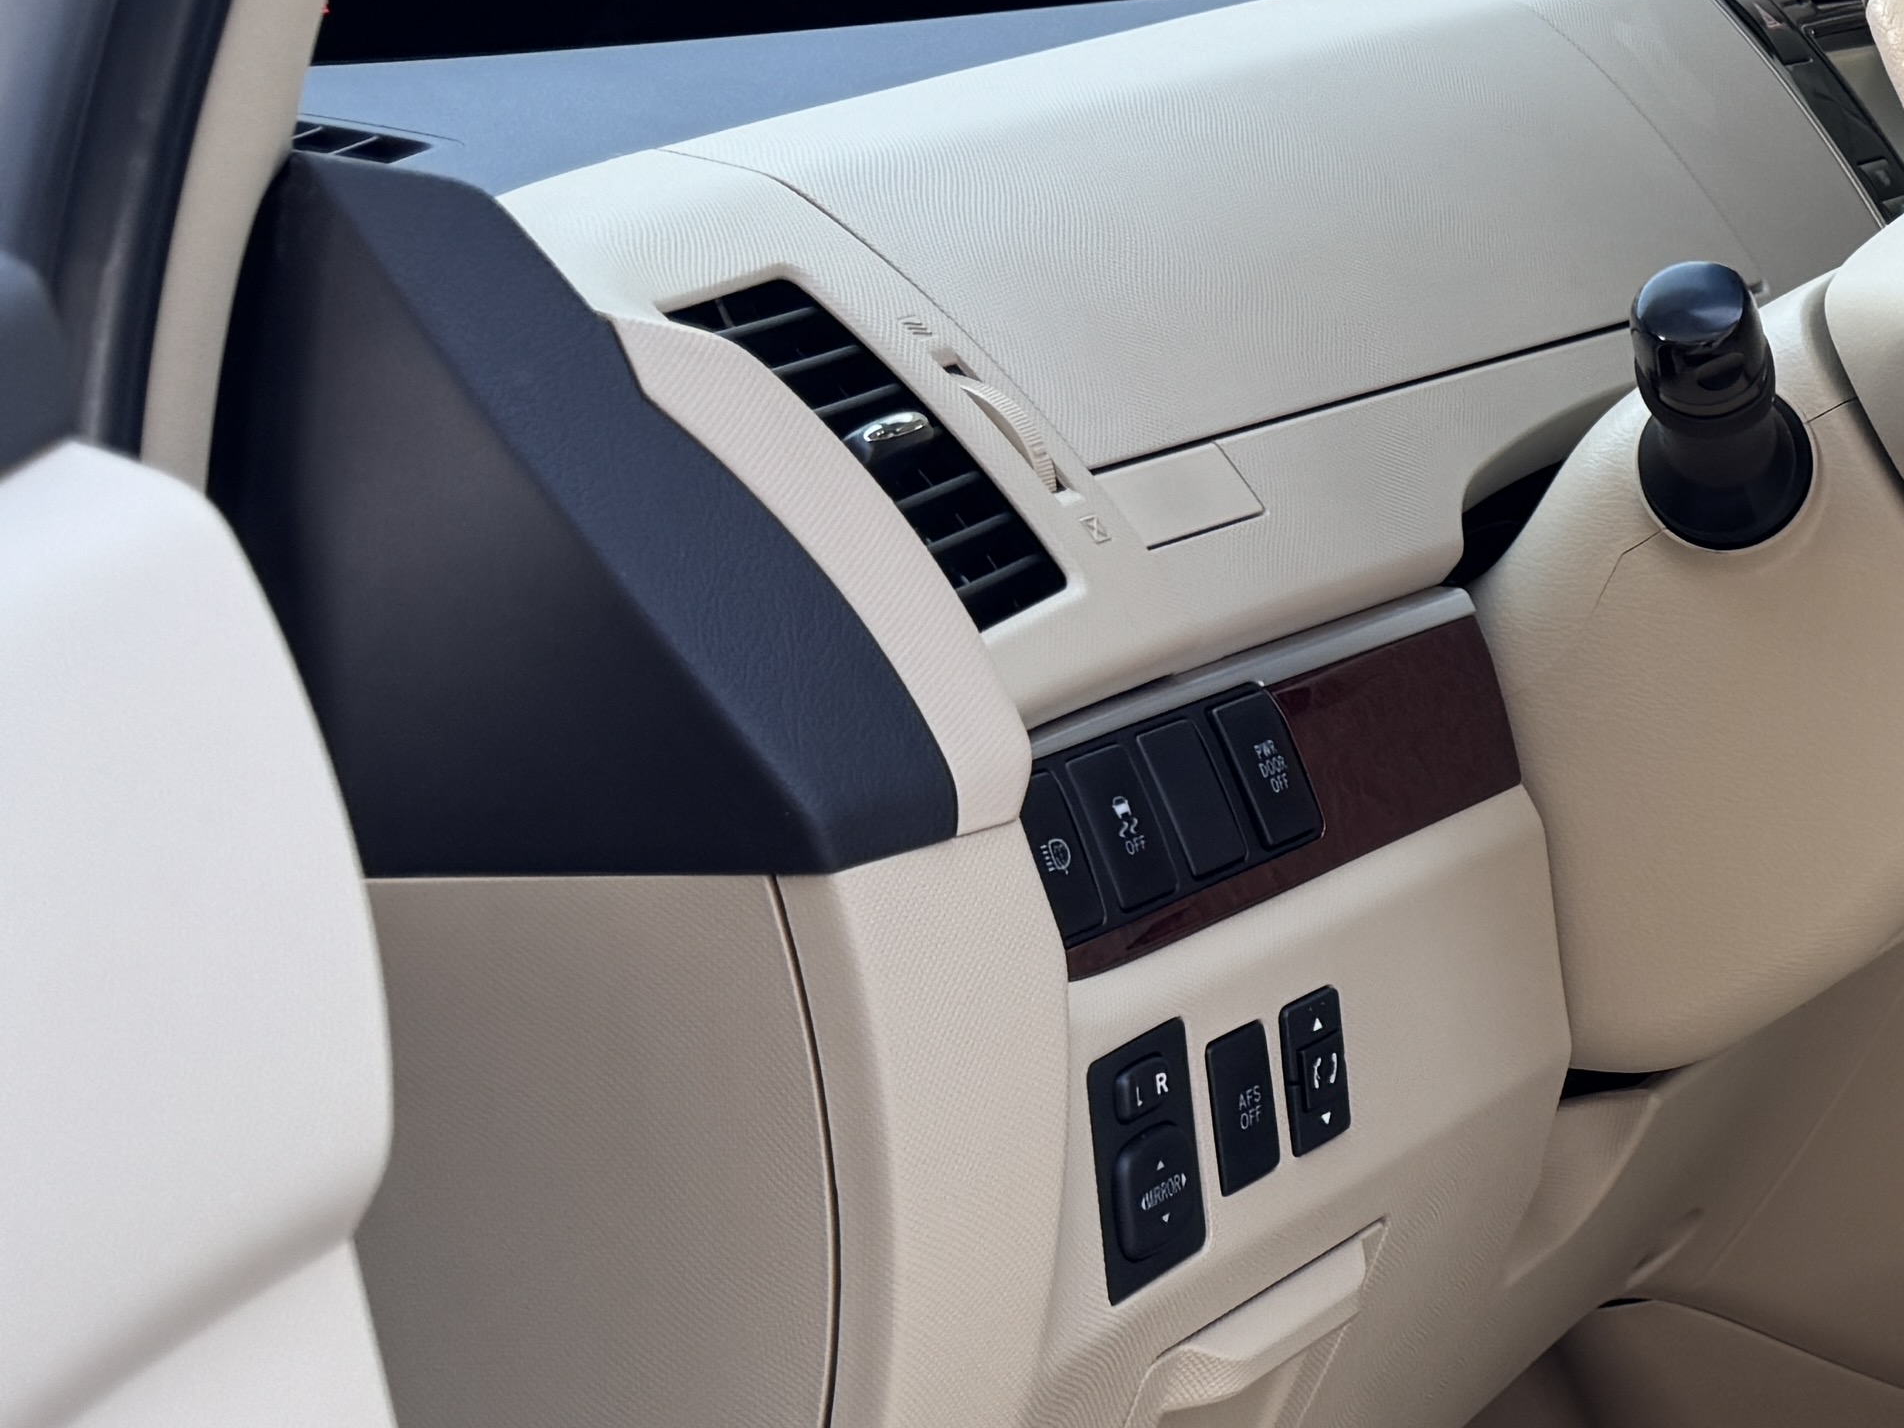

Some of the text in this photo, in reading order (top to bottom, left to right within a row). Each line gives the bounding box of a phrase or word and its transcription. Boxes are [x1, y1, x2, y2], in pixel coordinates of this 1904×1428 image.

[1253, 739, 1277, 760] PWR
[1258, 755, 1288, 778] DOOR
[1270, 772, 1288, 793] OFF
[1125, 834, 1145, 856] OFF
[1155, 1072, 1169, 1095] R
[1239, 1084, 1261, 1111] AFS
[1240, 1104, 1261, 1130] OFF
